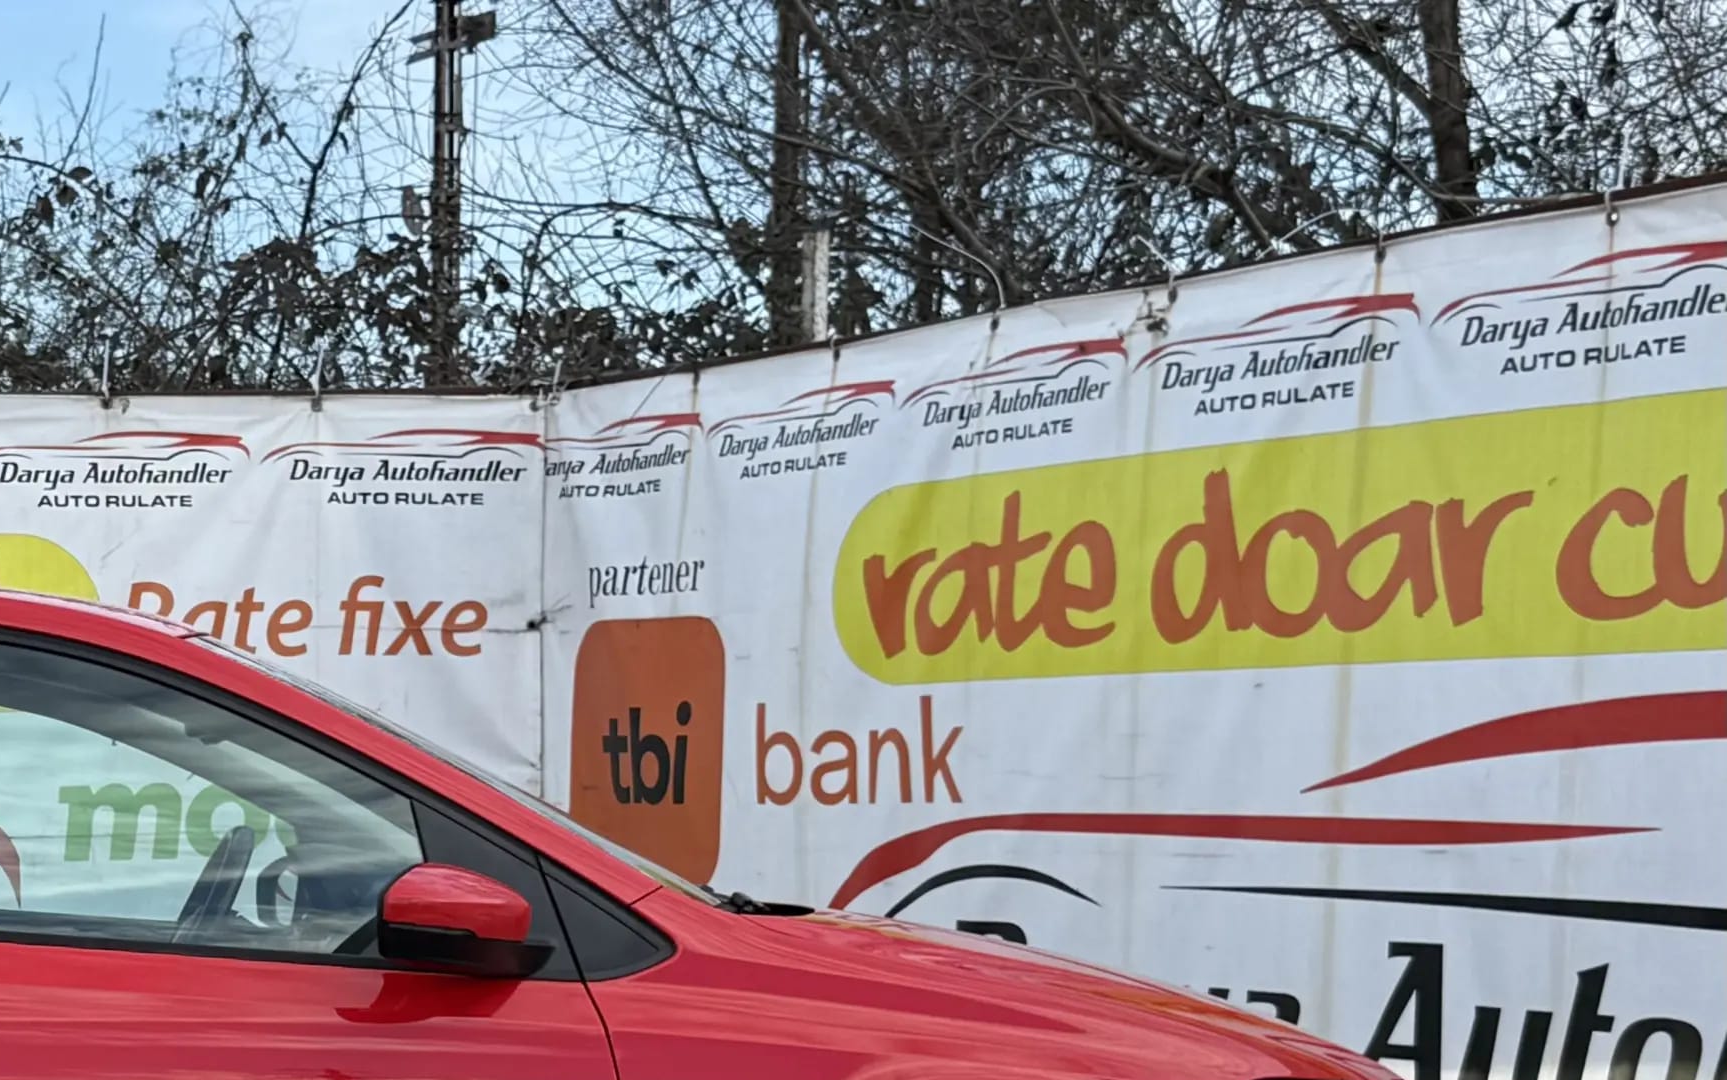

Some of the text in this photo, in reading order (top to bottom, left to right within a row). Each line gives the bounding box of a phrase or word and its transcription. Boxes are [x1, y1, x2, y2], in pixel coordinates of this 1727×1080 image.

[1461, 284, 1727, 350] Darya Autohandle
[1161, 334, 1400, 393] Darya Autohandler
[1500, 335, 1686, 375] AUTO RULATE
[923, 376, 1110, 429] Darya Autohandler
[1194, 381, 1354, 416] AUTO RULATE
[719, 413, 879, 460] Darya Autohandler
[952, 418, 1073, 450] AUTO RULATE
[0, 462, 233, 490] Darya Autohandler
[290, 459, 527, 487] Darya Autohandler
[545, 444, 691, 482] arya Autohandler
[740, 452, 847, 479] AUTO RULATE
[37, 495, 192, 508] AUTO RULATE
[328, 492, 484, 505] AUTO RULATE
[559, 479, 661, 499] AUTO RULATE
[589, 557, 705, 608] partener
[863, 490, 1116, 660] rate
[1152, 467, 1534, 645] doar
[338, 575, 488, 657] fixe
[602, 695, 963, 805] tbi bank
